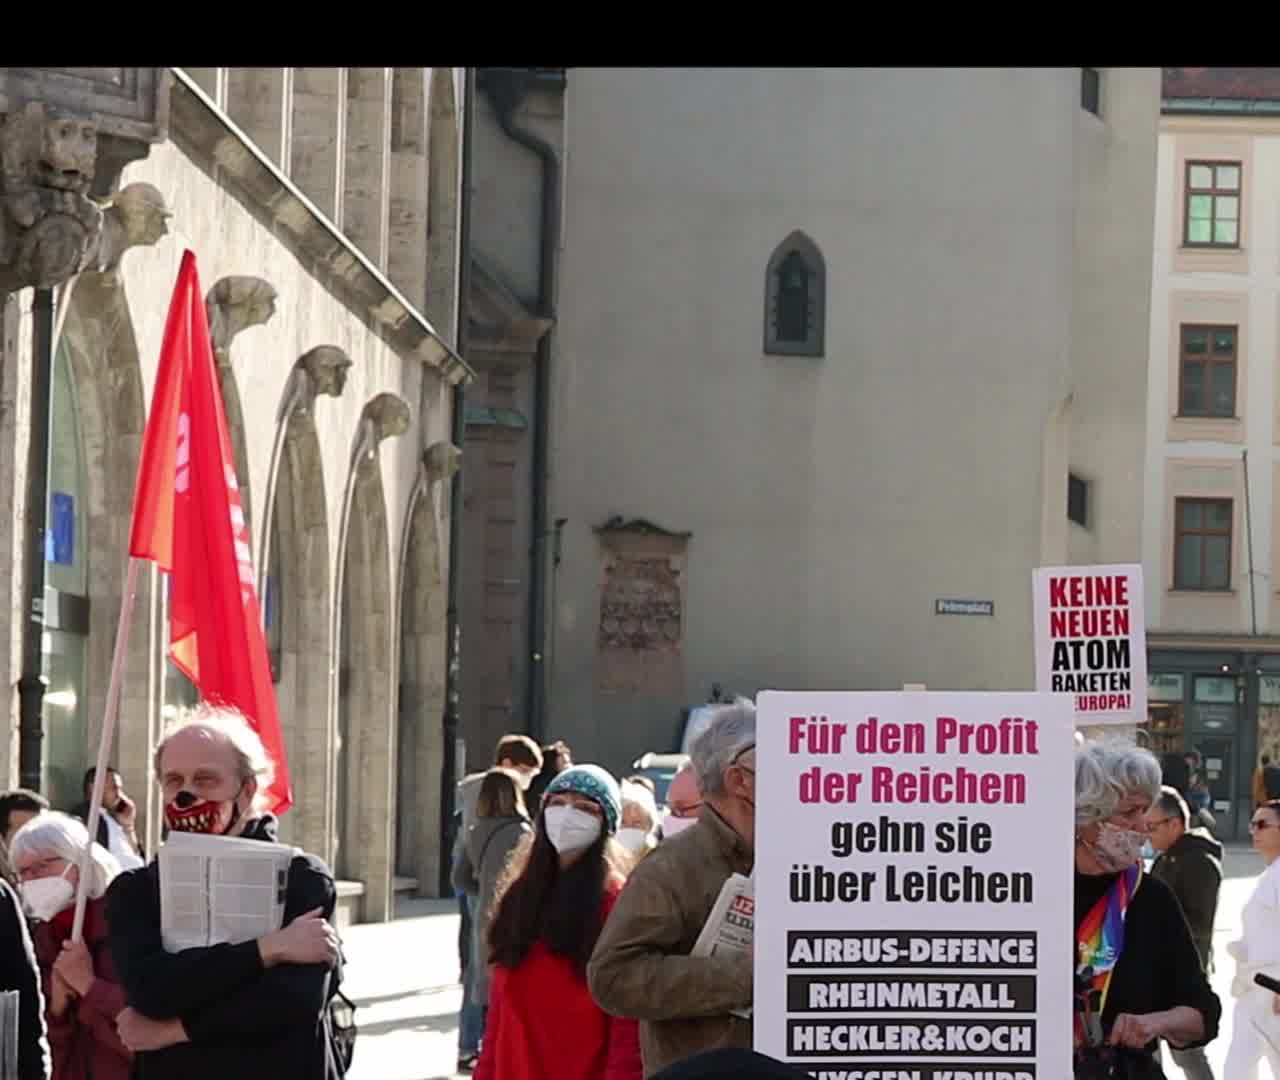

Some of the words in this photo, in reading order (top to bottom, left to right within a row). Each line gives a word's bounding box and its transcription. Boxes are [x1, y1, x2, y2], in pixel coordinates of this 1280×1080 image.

[1050, 576, 1129, 607] KEINE
[1050, 609, 1130, 637] NEUEN
[1052, 639, 1131, 671] ATOM
[1052, 672, 1131, 692] RAKETEN
[1075, 694, 1131, 711] UROPA!
[789, 716, 848, 754] Für
[855, 717, 926, 754] den
[935, 717, 1040, 755] Profit
[799, 766, 864, 804] der
[871, 766, 1027, 804] Reichen
[831, 815, 926, 858] gehn
[935, 816, 993, 853] sie
[789, 863, 877, 903] über
[885, 865, 1034, 903] Leichen
[790, 938, 1035, 963] AIRBUS-DEFENCE
[808, 982, 1015, 1008] RHEINMETALL
[793, 1025, 1032, 1051] HECKLER&KOCH
